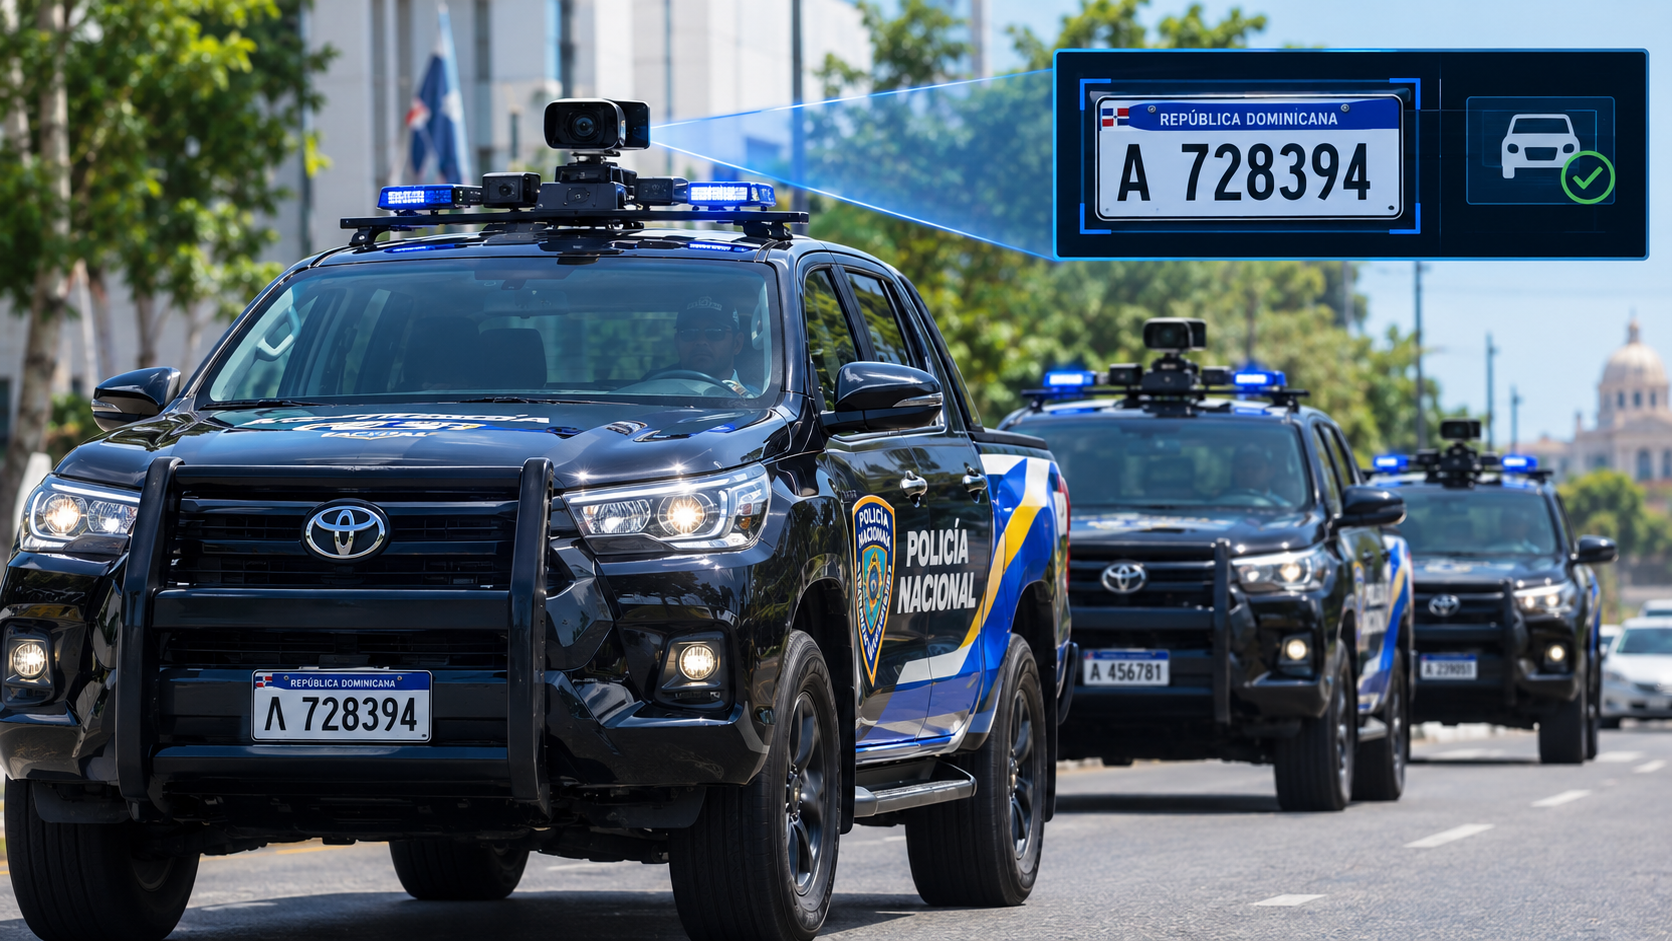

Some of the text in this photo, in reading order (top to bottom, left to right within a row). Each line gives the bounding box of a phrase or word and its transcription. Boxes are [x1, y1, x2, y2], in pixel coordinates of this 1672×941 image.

[859, 507, 889, 529] POLICÍA
[906, 518, 969, 567] POLICÍA
[897, 572, 976, 614] NACIONAL
[290, 677, 395, 687] REPÚBLICA DOMINICANA
[1090, 662, 1161, 681] A 456781
[302, 697, 417, 731] 728394
